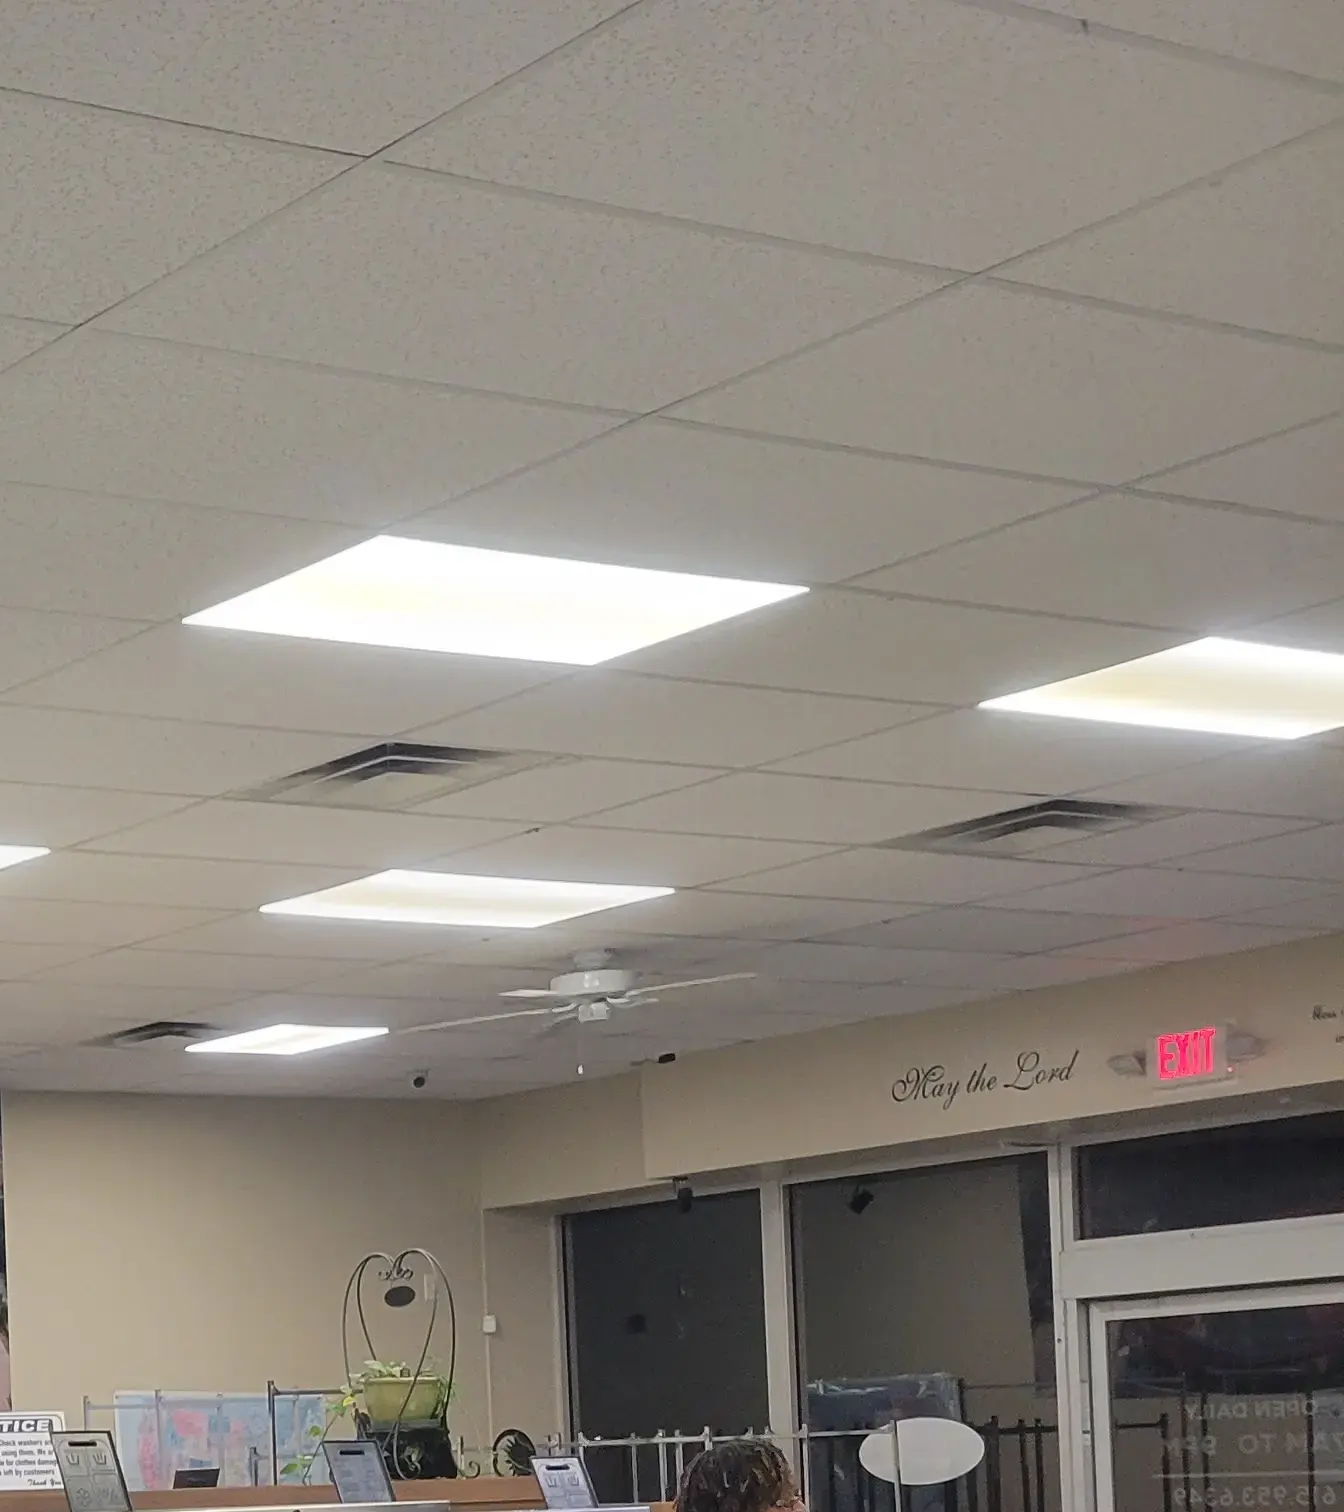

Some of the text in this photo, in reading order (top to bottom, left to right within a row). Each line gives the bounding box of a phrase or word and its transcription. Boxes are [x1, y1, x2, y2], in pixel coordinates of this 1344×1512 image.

[1157, 1028, 1216, 1080] EXIT
[892, 1049, 1080, 1110] May the Lord
[18, 1439, 42, 1447] washers
[1, 1450, 18, 1458] using
[37, 1448, 46, 1456] We
[15, 1458, 36, 1466] clothes
[14, 1469, 22, 1478] by
[23, 1468, 55, 1476] customers
[27, 1478, 47, 1486] Thank
